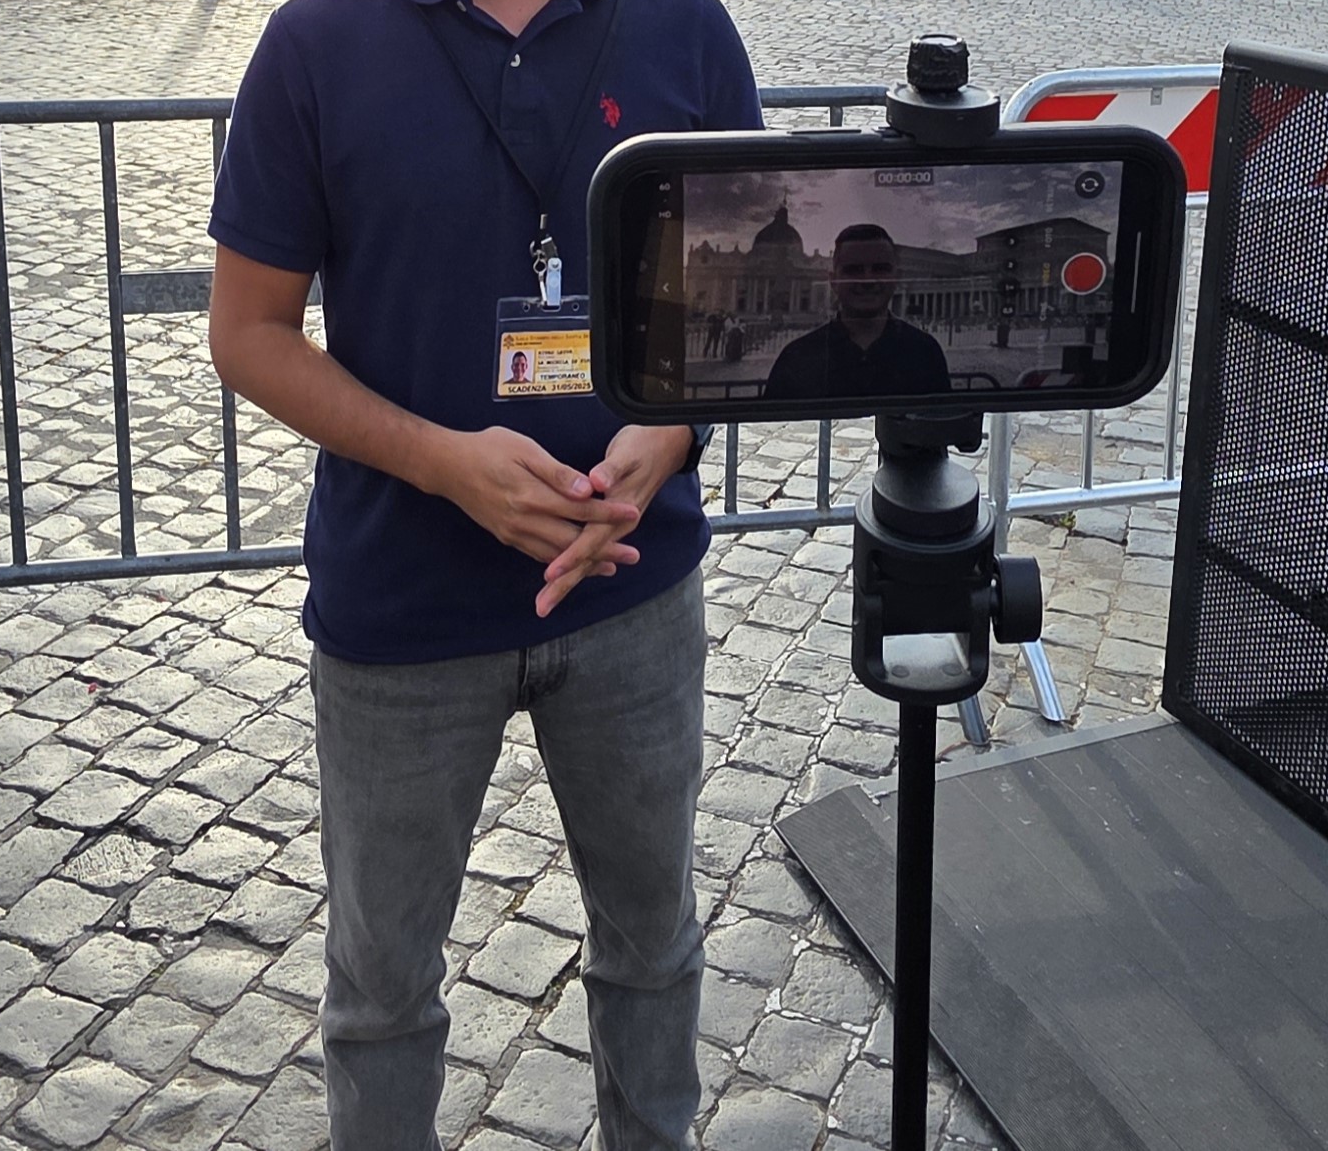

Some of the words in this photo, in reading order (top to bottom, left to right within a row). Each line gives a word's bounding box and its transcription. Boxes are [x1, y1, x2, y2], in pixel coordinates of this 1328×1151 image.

[878, 172, 931, 183] 00:00:00
[540, 372, 586, 380] TEMPORANEO
[508, 385, 547, 393] SCADENZA
